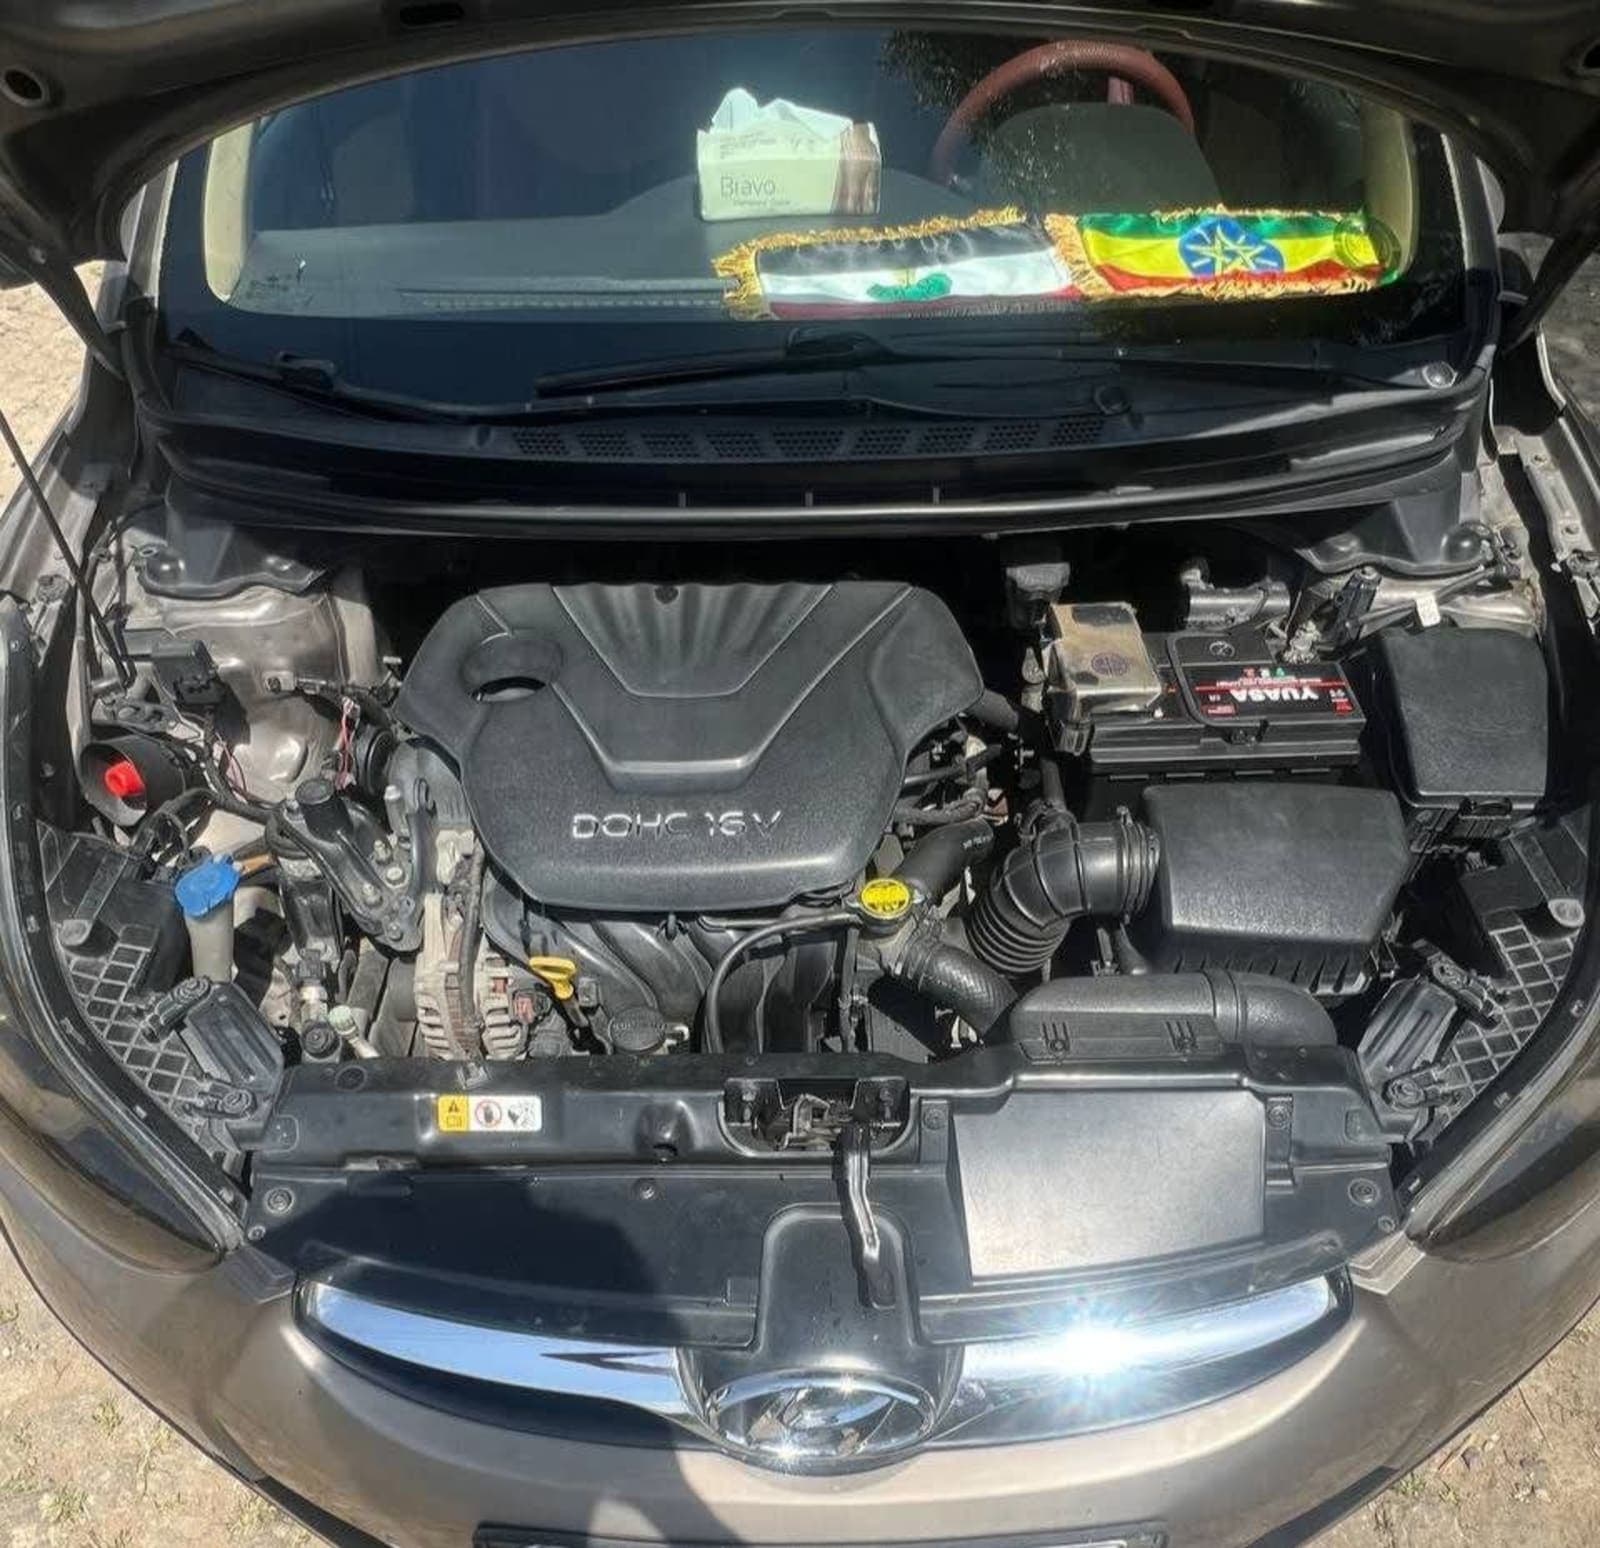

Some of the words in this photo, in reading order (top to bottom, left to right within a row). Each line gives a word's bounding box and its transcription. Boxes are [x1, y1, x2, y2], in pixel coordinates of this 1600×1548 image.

[720, 175, 776, 198] Bravo
[1229, 685, 1319, 703] YUASA
[572, 811, 690, 839] DOHC
